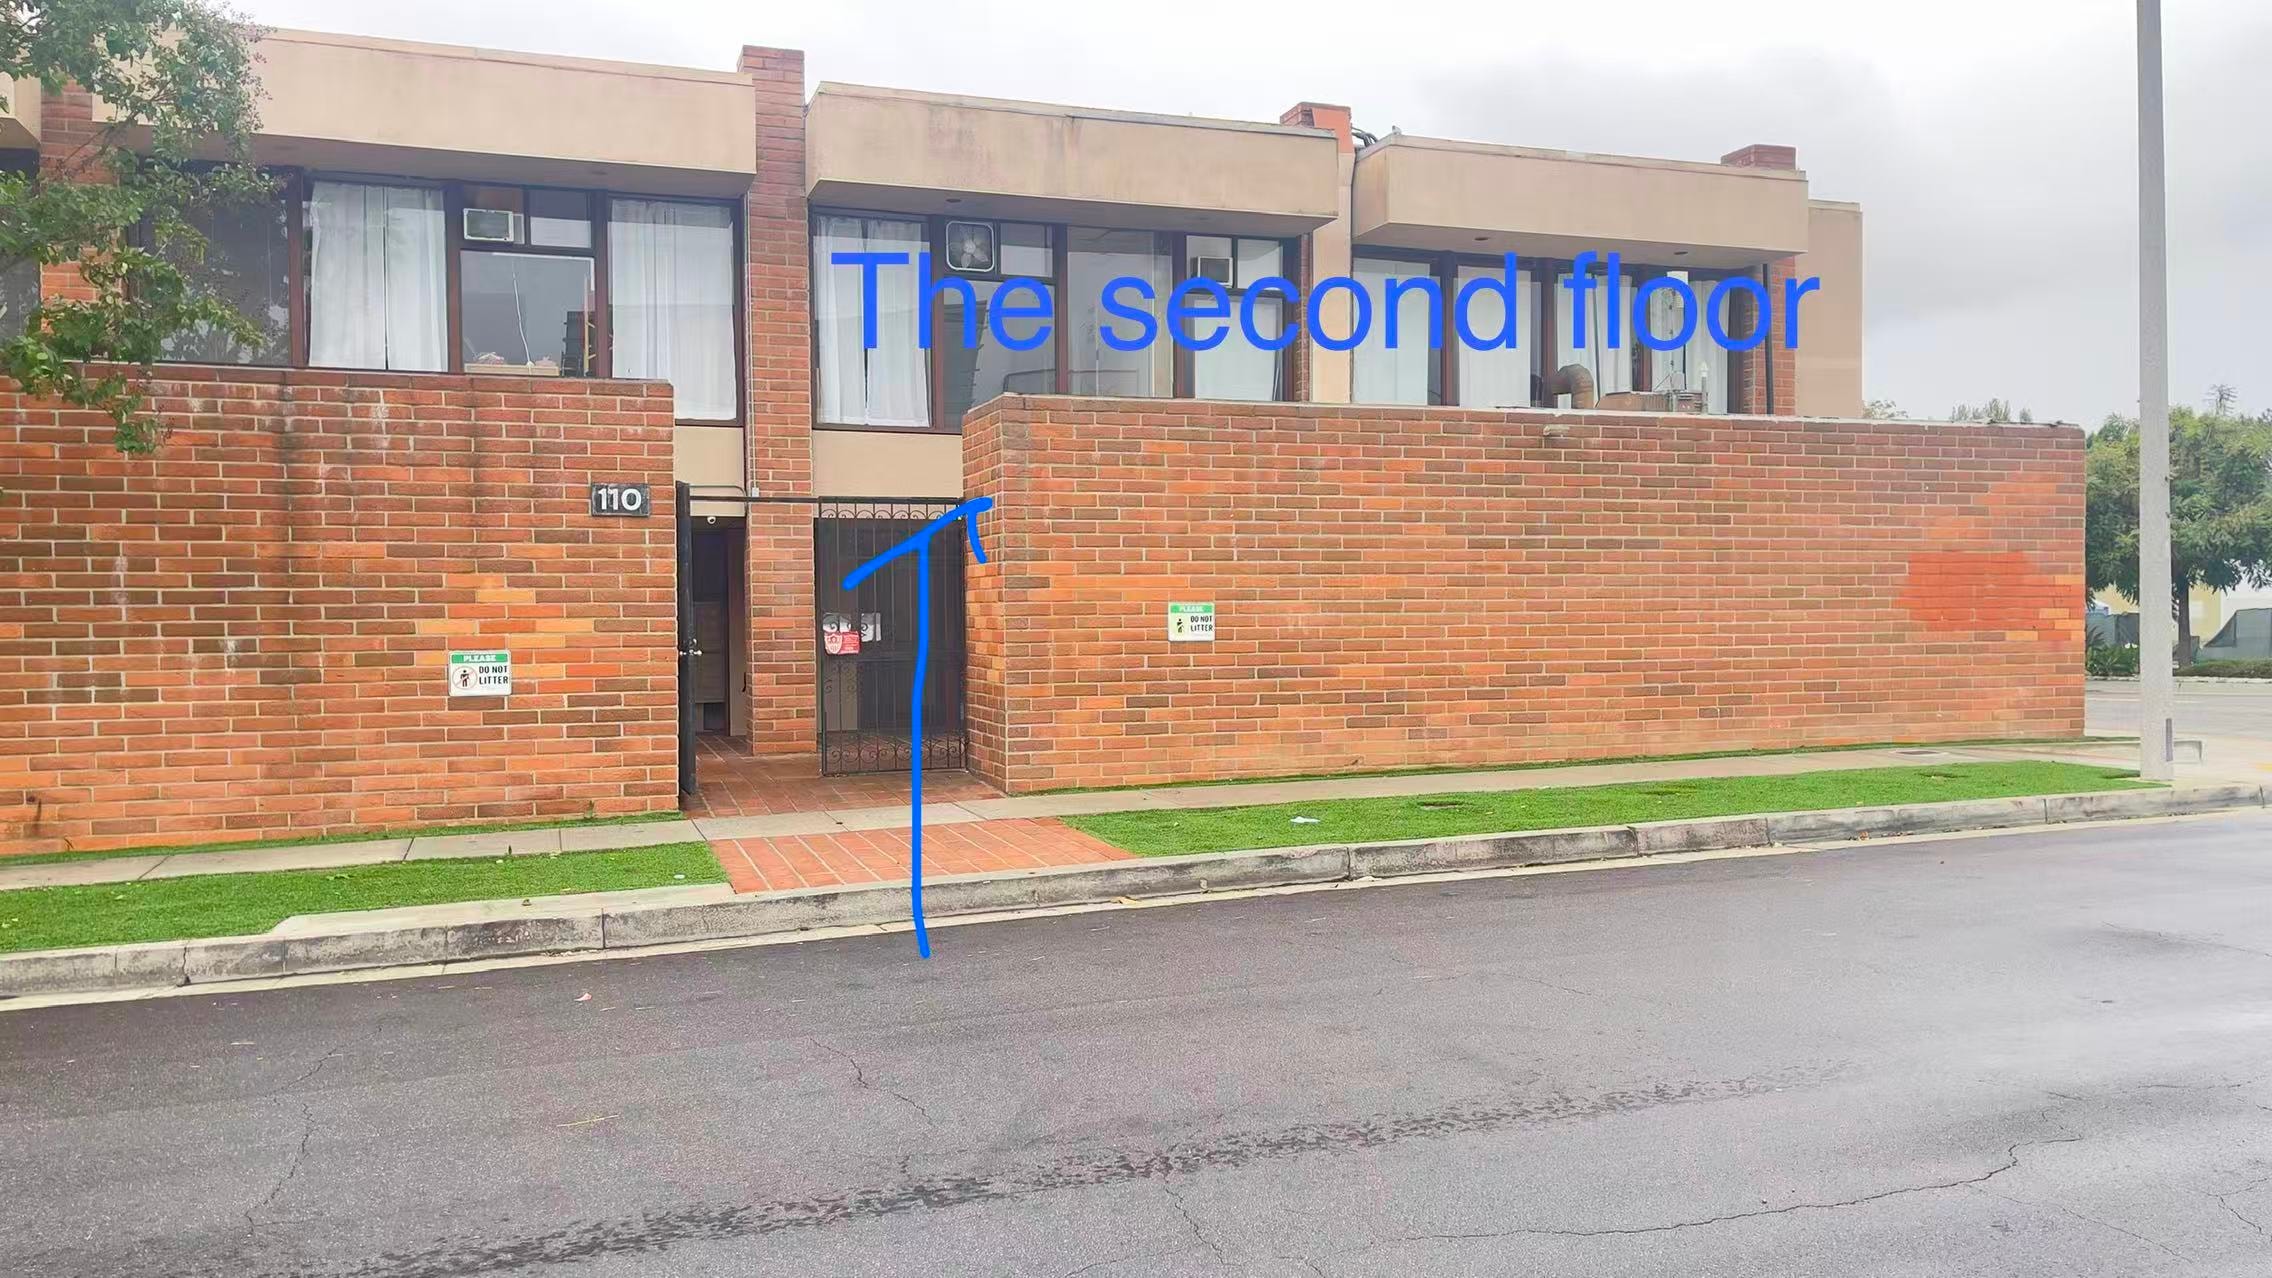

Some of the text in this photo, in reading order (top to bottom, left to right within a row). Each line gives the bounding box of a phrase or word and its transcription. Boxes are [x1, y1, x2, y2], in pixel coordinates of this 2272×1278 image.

[598, 488, 642, 511] 110
[1190, 615, 1213, 623] DO NOT
[1190, 624, 1213, 632] LITTER
[463, 654, 497, 663] PLEASE
[479, 665, 508, 674] DO NOT
[479, 676, 508, 684] LITTER
